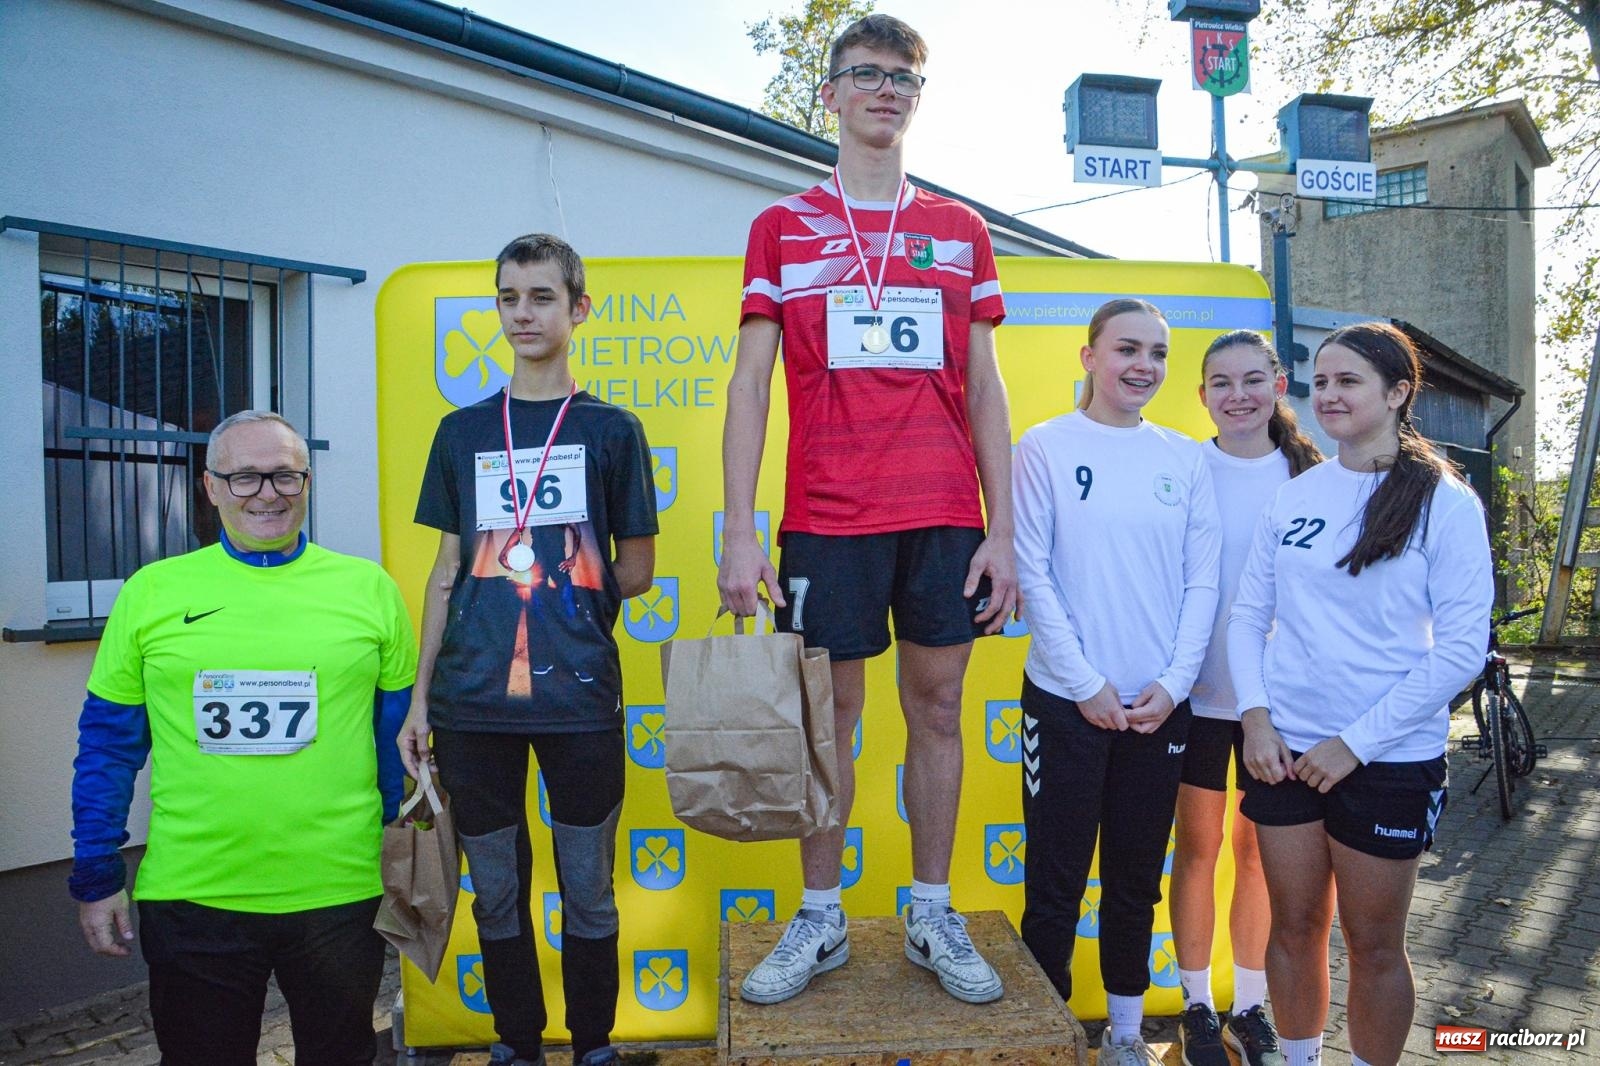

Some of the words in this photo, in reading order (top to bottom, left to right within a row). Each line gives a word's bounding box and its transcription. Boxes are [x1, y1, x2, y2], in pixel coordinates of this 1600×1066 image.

[1208, 56, 1237, 71] START
[1084, 156, 1151, 180] START
[1301, 165, 1373, 193] GOŚCIE
[584, 293, 687, 323] MINA
[881, 296, 938, 304] w.personalbest.pl
[854, 315, 919, 353] 76
[586, 378, 716, 408] IELKIE
[515, 453, 581, 464] www.peonalbest.pl
[500, 474, 562, 513] 96
[1076, 465, 1093, 501] 9
[1281, 517, 1326, 550] 22
[789, 577, 810, 631] 7
[240, 679, 311, 688] www.personalbest.pl
[202, 701, 311, 739] 337
[1374, 824, 1418, 839] hummel
